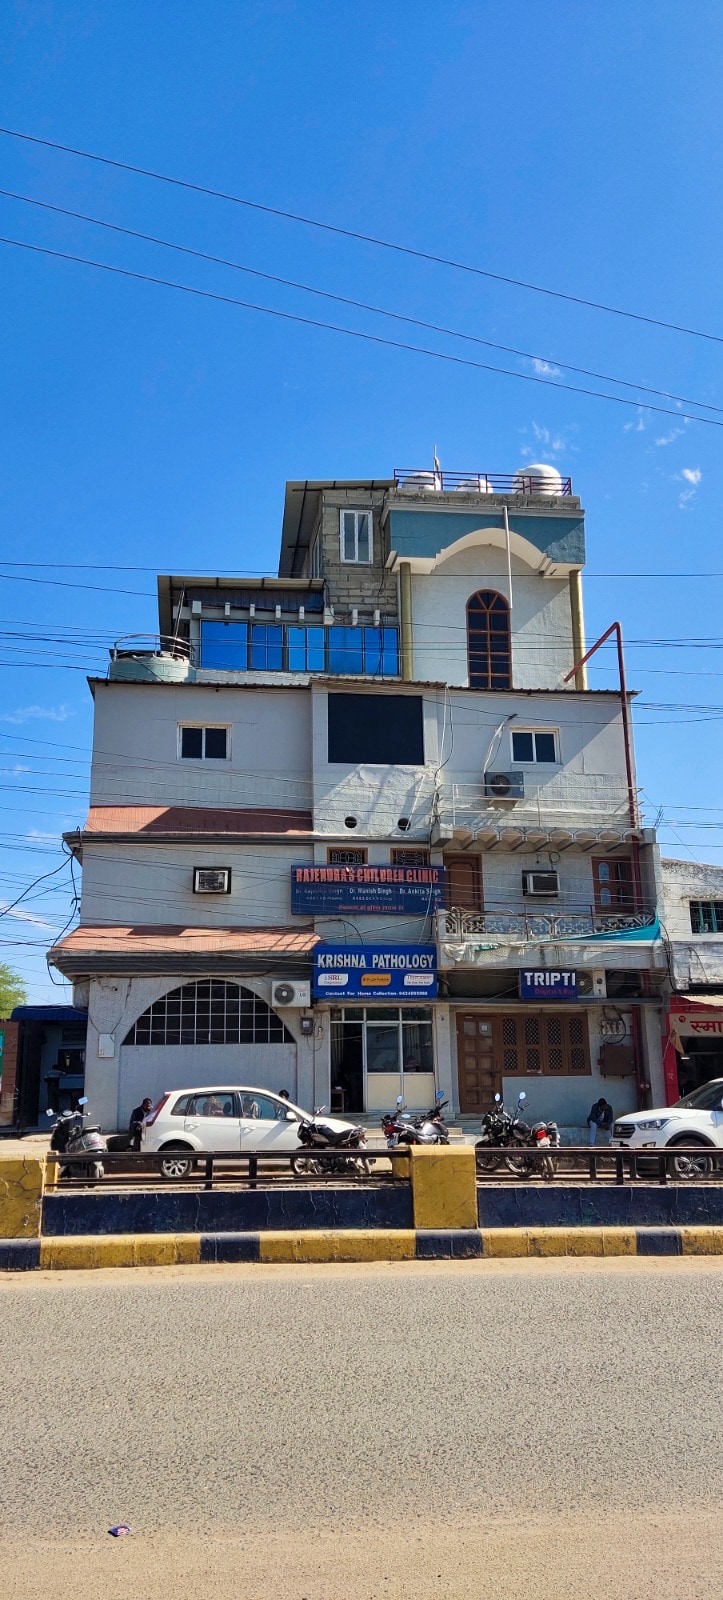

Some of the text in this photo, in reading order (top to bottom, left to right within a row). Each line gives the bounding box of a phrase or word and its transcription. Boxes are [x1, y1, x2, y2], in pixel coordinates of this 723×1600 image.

[296, 867, 439, 883] RAJENDRA'S CHILDREN CLINIC
[317, 954, 434, 968] KRISHNA PATHOLOGY
[524, 972, 576, 986] TRIPTI
